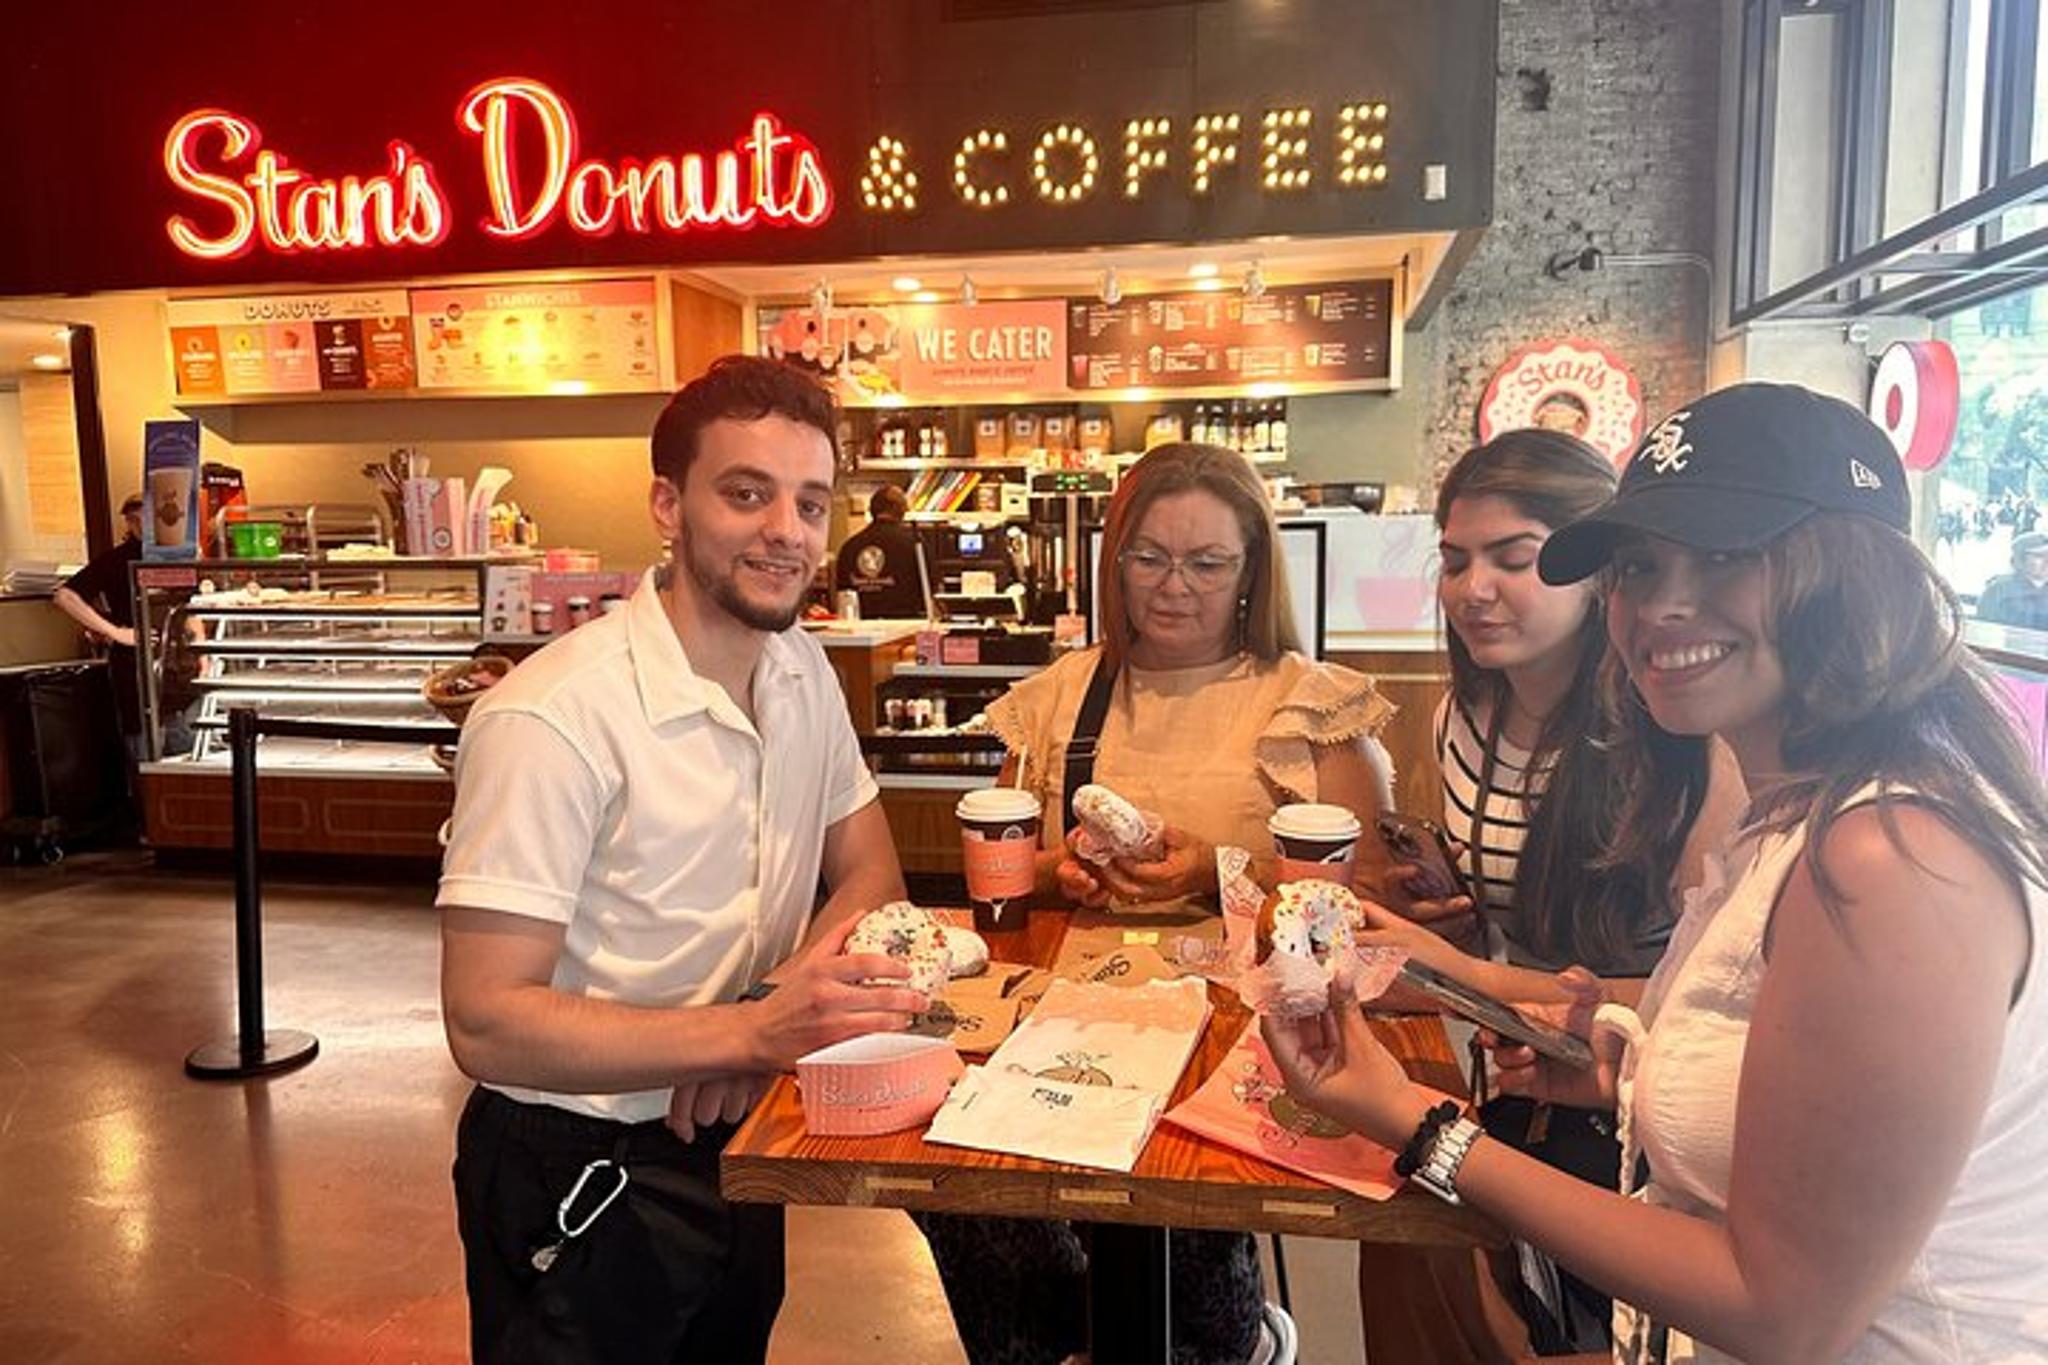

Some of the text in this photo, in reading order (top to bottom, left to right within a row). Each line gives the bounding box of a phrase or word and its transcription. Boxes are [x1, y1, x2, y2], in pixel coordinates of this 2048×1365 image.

[163, 76, 1391, 258] Stan's Donuts & COFFEE
[243, 299, 333, 321] DONUTS
[914, 326, 958, 362] WE
[968, 325, 1054, 362] CATER
[1517, 358, 1608, 397] Stan's
